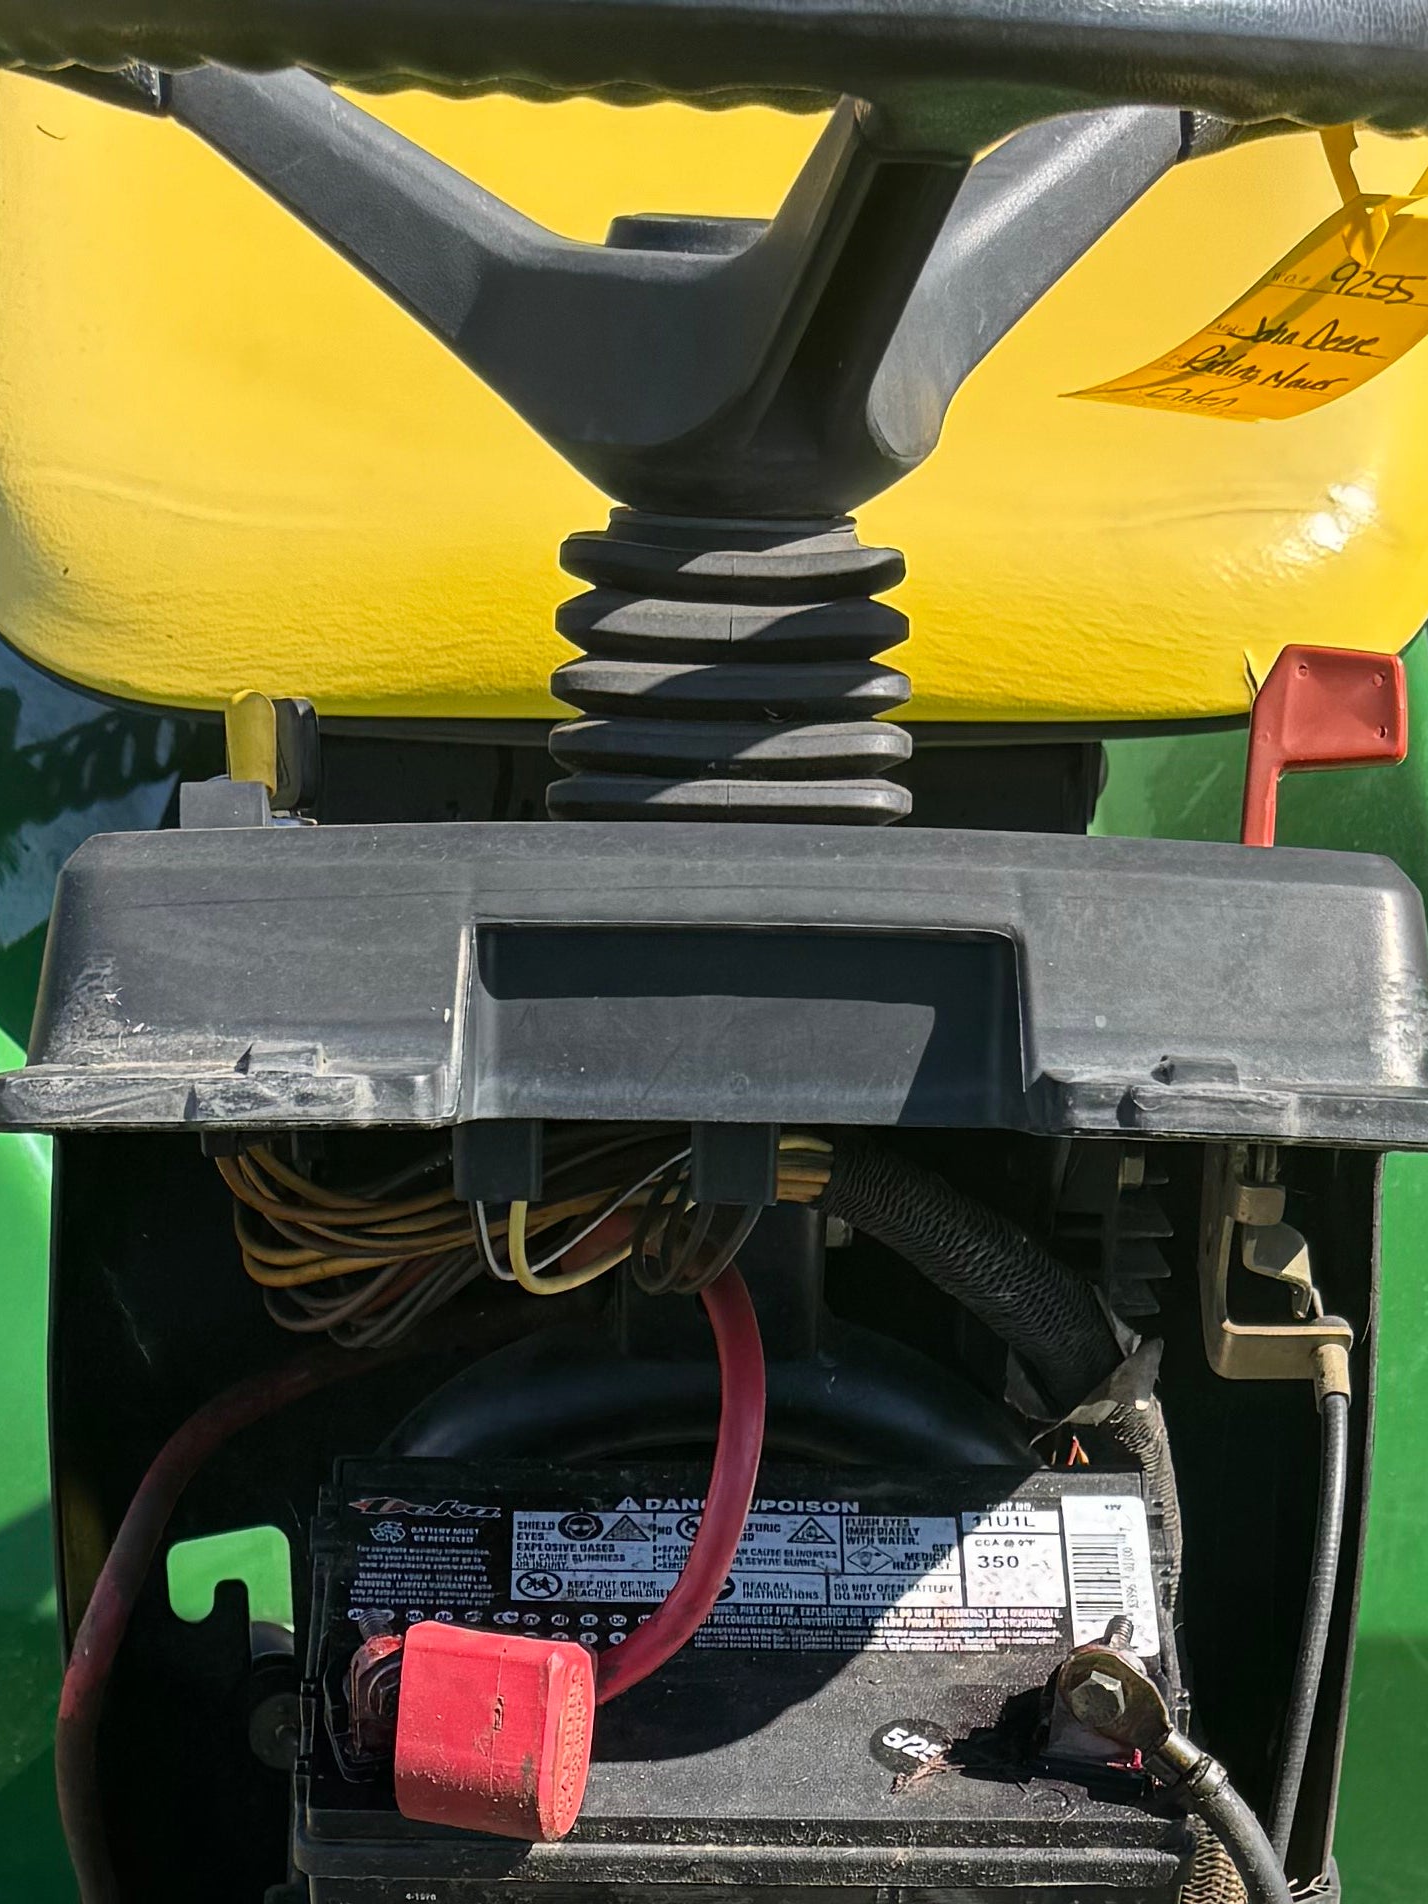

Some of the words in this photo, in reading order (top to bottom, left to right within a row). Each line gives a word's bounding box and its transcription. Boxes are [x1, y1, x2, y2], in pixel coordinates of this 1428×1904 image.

[1330, 263, 1427, 304] 9255
[517, 1521, 555, 1530] SHIELD
[972, 1515, 1036, 1528] 11U1L
[846, 1527, 920, 1536] IMMEDIATELY
[517, 1543, 577, 1551] EXPLOSIVE
[977, 1555, 1020, 1568] 350
